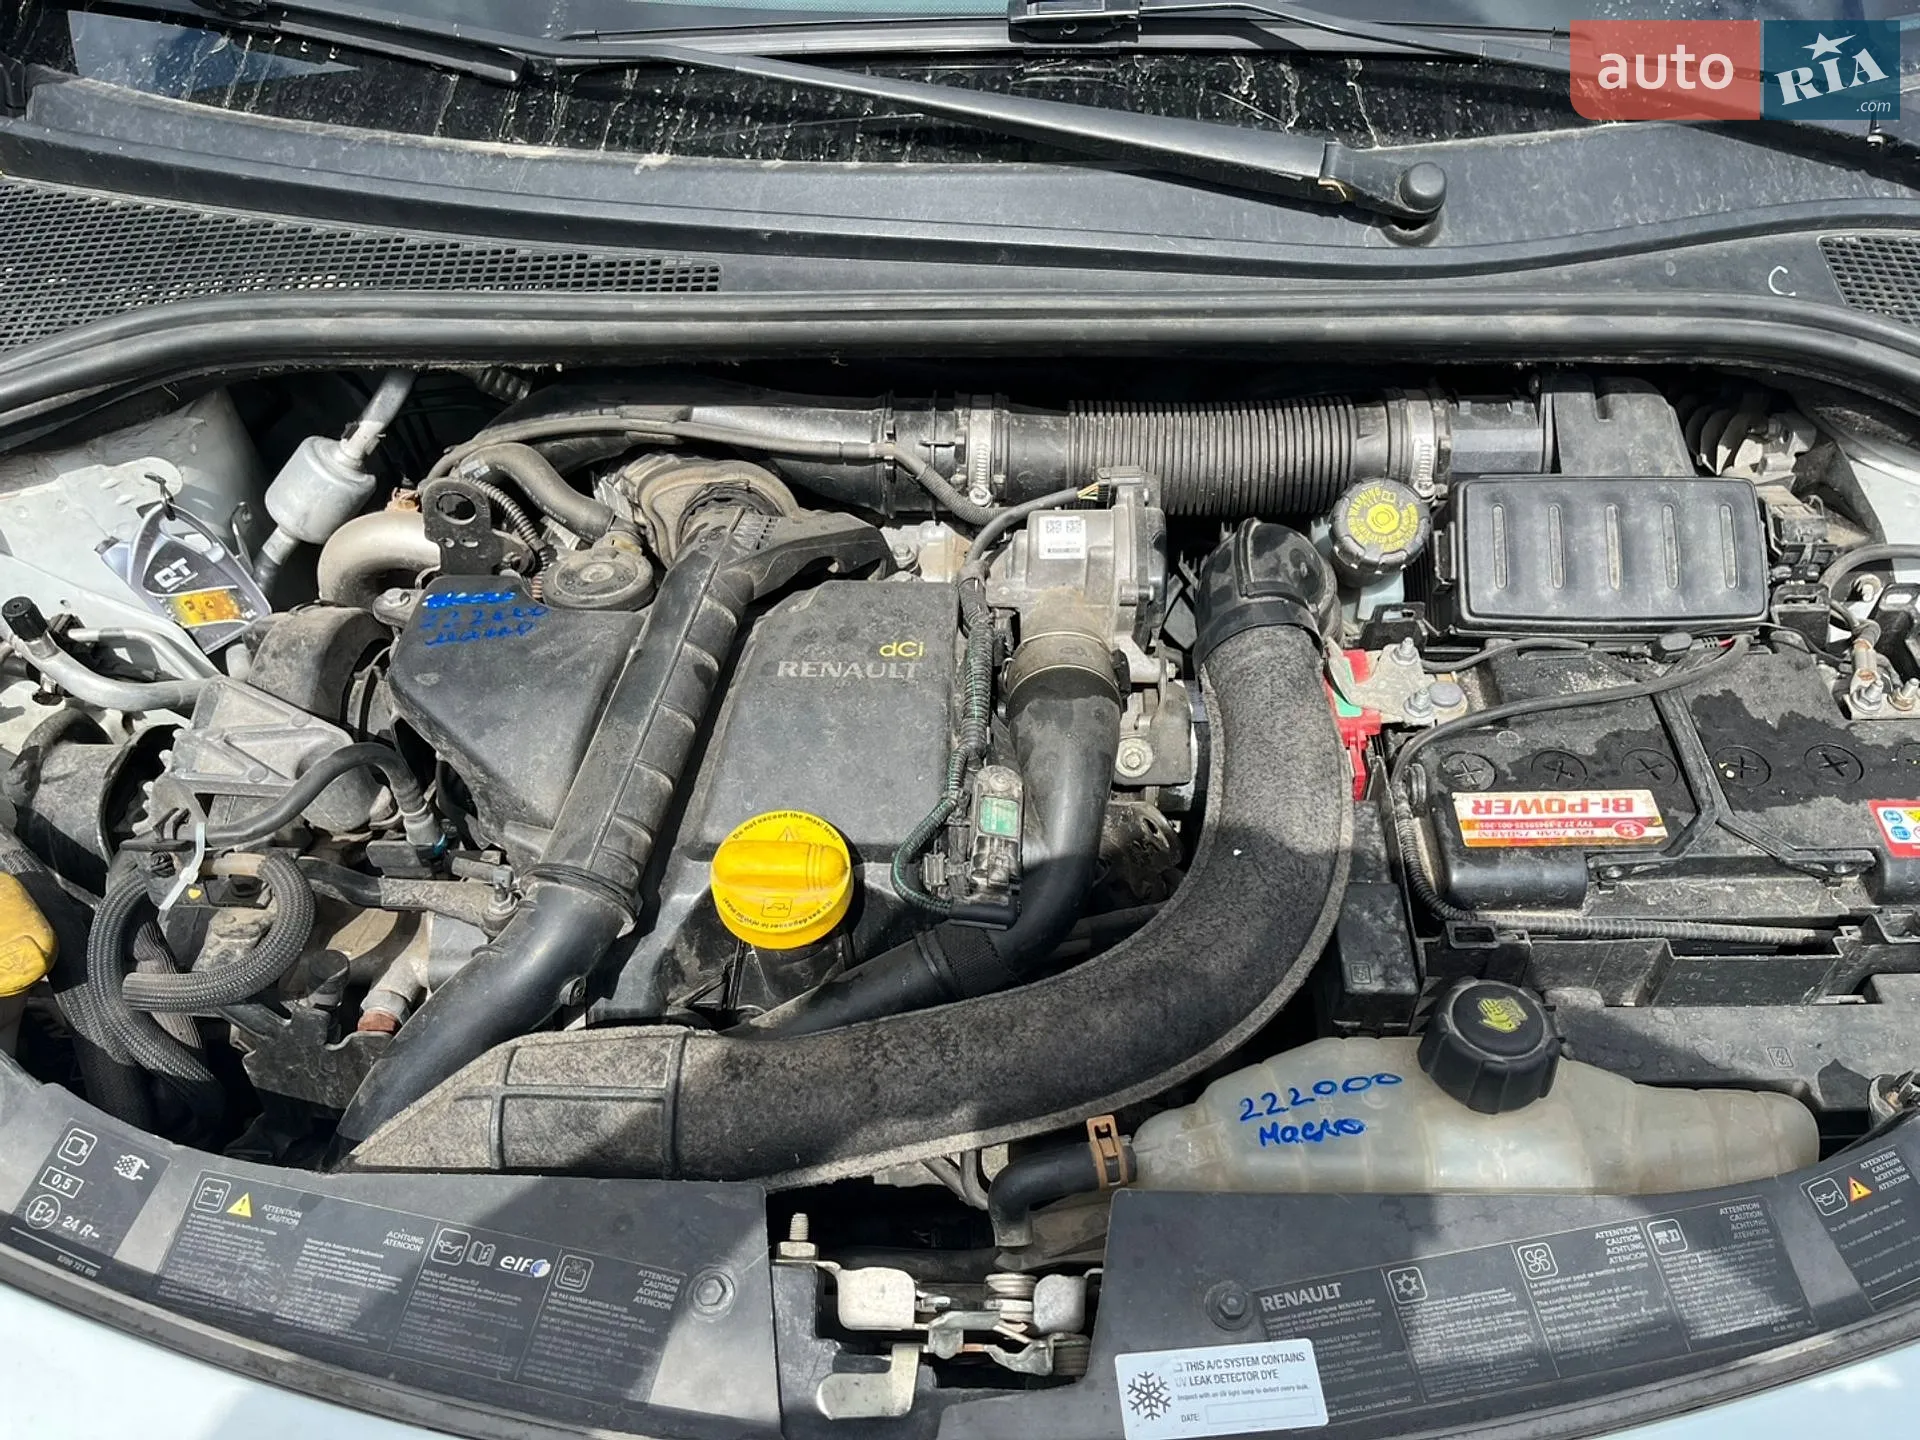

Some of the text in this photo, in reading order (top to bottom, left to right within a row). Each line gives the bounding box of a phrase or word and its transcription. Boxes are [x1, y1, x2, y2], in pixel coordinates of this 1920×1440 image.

[879, 641, 925, 657] dCi
[777, 661, 923, 679] RENAULT
[1472, 797, 1634, 815] Bi-POWER
[1240, 1073, 1402, 1121] 222000
[51, 1173, 73, 1190] 0,5
[261, 1204, 303, 1219] ATTENTION
[266, 1213, 300, 1226] CAUTION
[62, 1216, 80, 1231] 24
[386, 1230, 425, 1245] ACHTUNG
[1595, 1226, 1639, 1240] ATTENTION
[1605, 1234, 1642, 1246] CAUTION
[499, 1255, 533, 1273] elf
[637, 1269, 681, 1285] ATTENTION
[643, 1279, 679, 1293] CAUTION
[1259, 1283, 1343, 1312] RENAULT
[1185, 1352, 1306, 1372] THIS A/C SYSTEM CONTAINS
[1189, 1374, 1213, 1387] LEAK
[1213, 1370, 1260, 1385] DETECTOR
[1261, 1369, 1279, 1381] DYE
